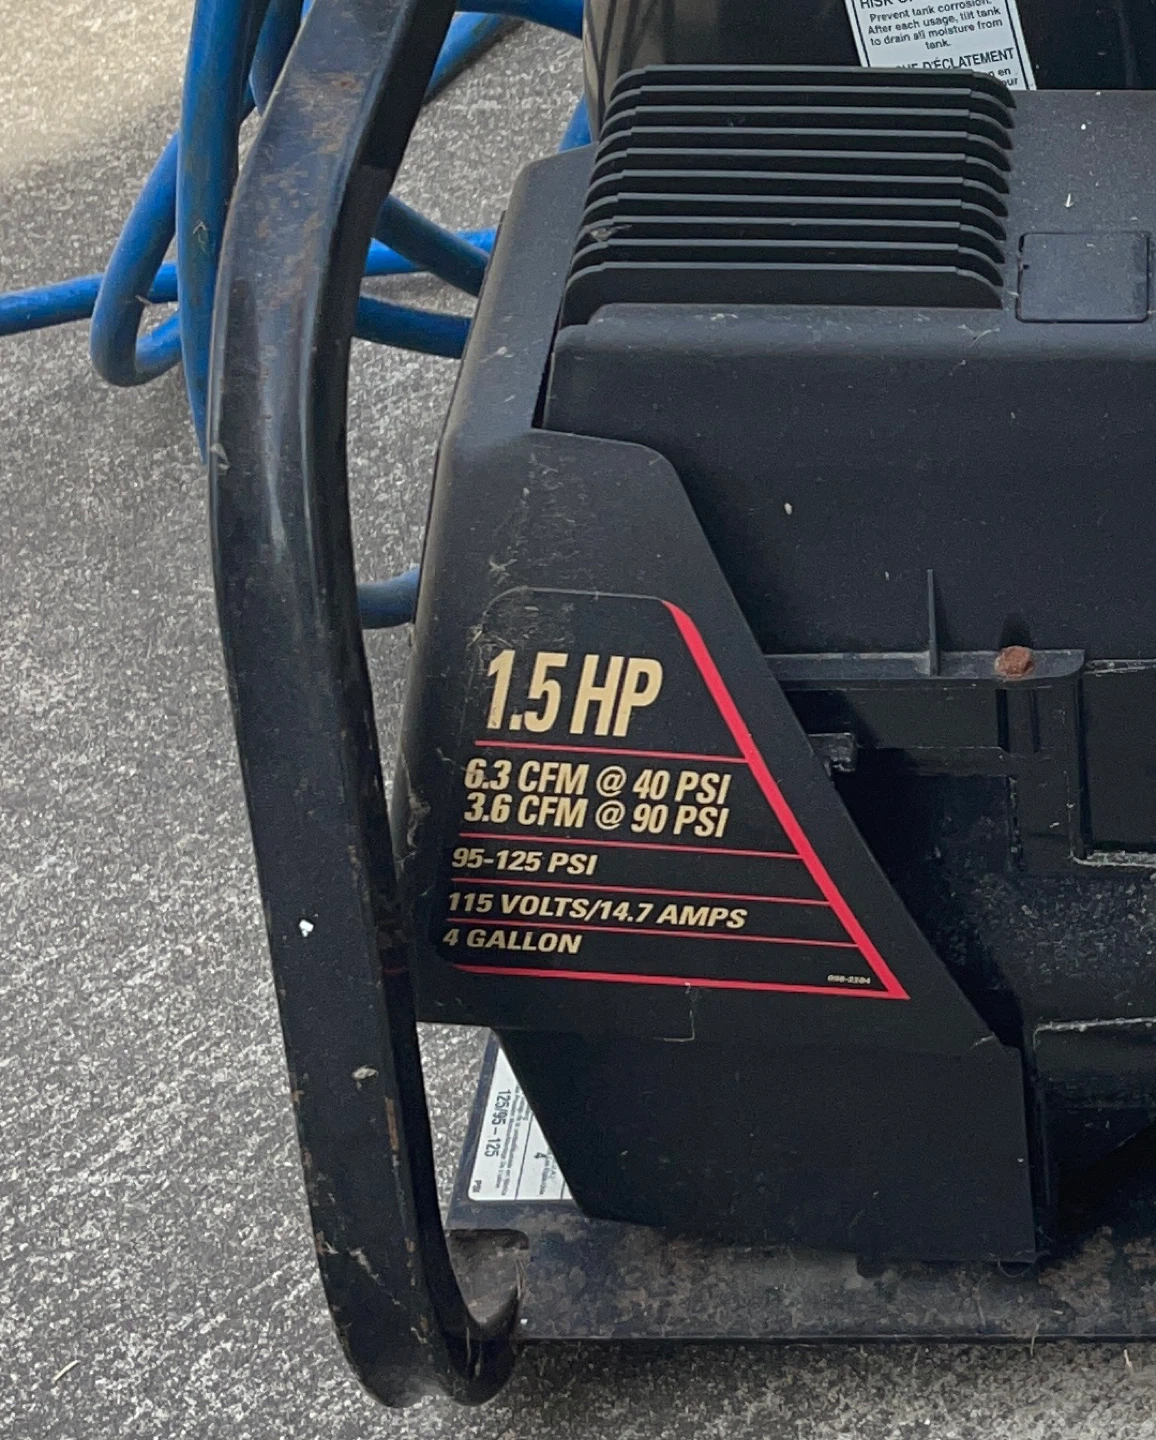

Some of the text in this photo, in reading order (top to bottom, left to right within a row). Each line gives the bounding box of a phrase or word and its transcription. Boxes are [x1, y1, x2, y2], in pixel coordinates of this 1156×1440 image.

[868, 23, 892, 34] After
[895, 20, 920, 30] each
[977, 7, 1001, 17] tank
[869, 11, 909, 23] Prevent
[913, 5, 935, 16] tank
[870, 38, 881, 46] to
[884, 33, 910, 44] drain
[929, 25, 975, 37] moisture
[977, 19, 1003, 29] from
[925, 39, 951, 49] tank.
[486, 649, 663, 737] 1.5 HP
[464, 759, 732, 804] 6.3 CFM @ 40 PSI
[464, 792, 729, 838] 3.6 CFM @ 90 PSI
[451, 847, 598, 875] 95-125 PSI
[449, 892, 748, 929] 115 VOLTS/14.7 AMPS
[443, 929, 582, 954] 4 GALLON
[483, 1137, 501, 1157] 125
